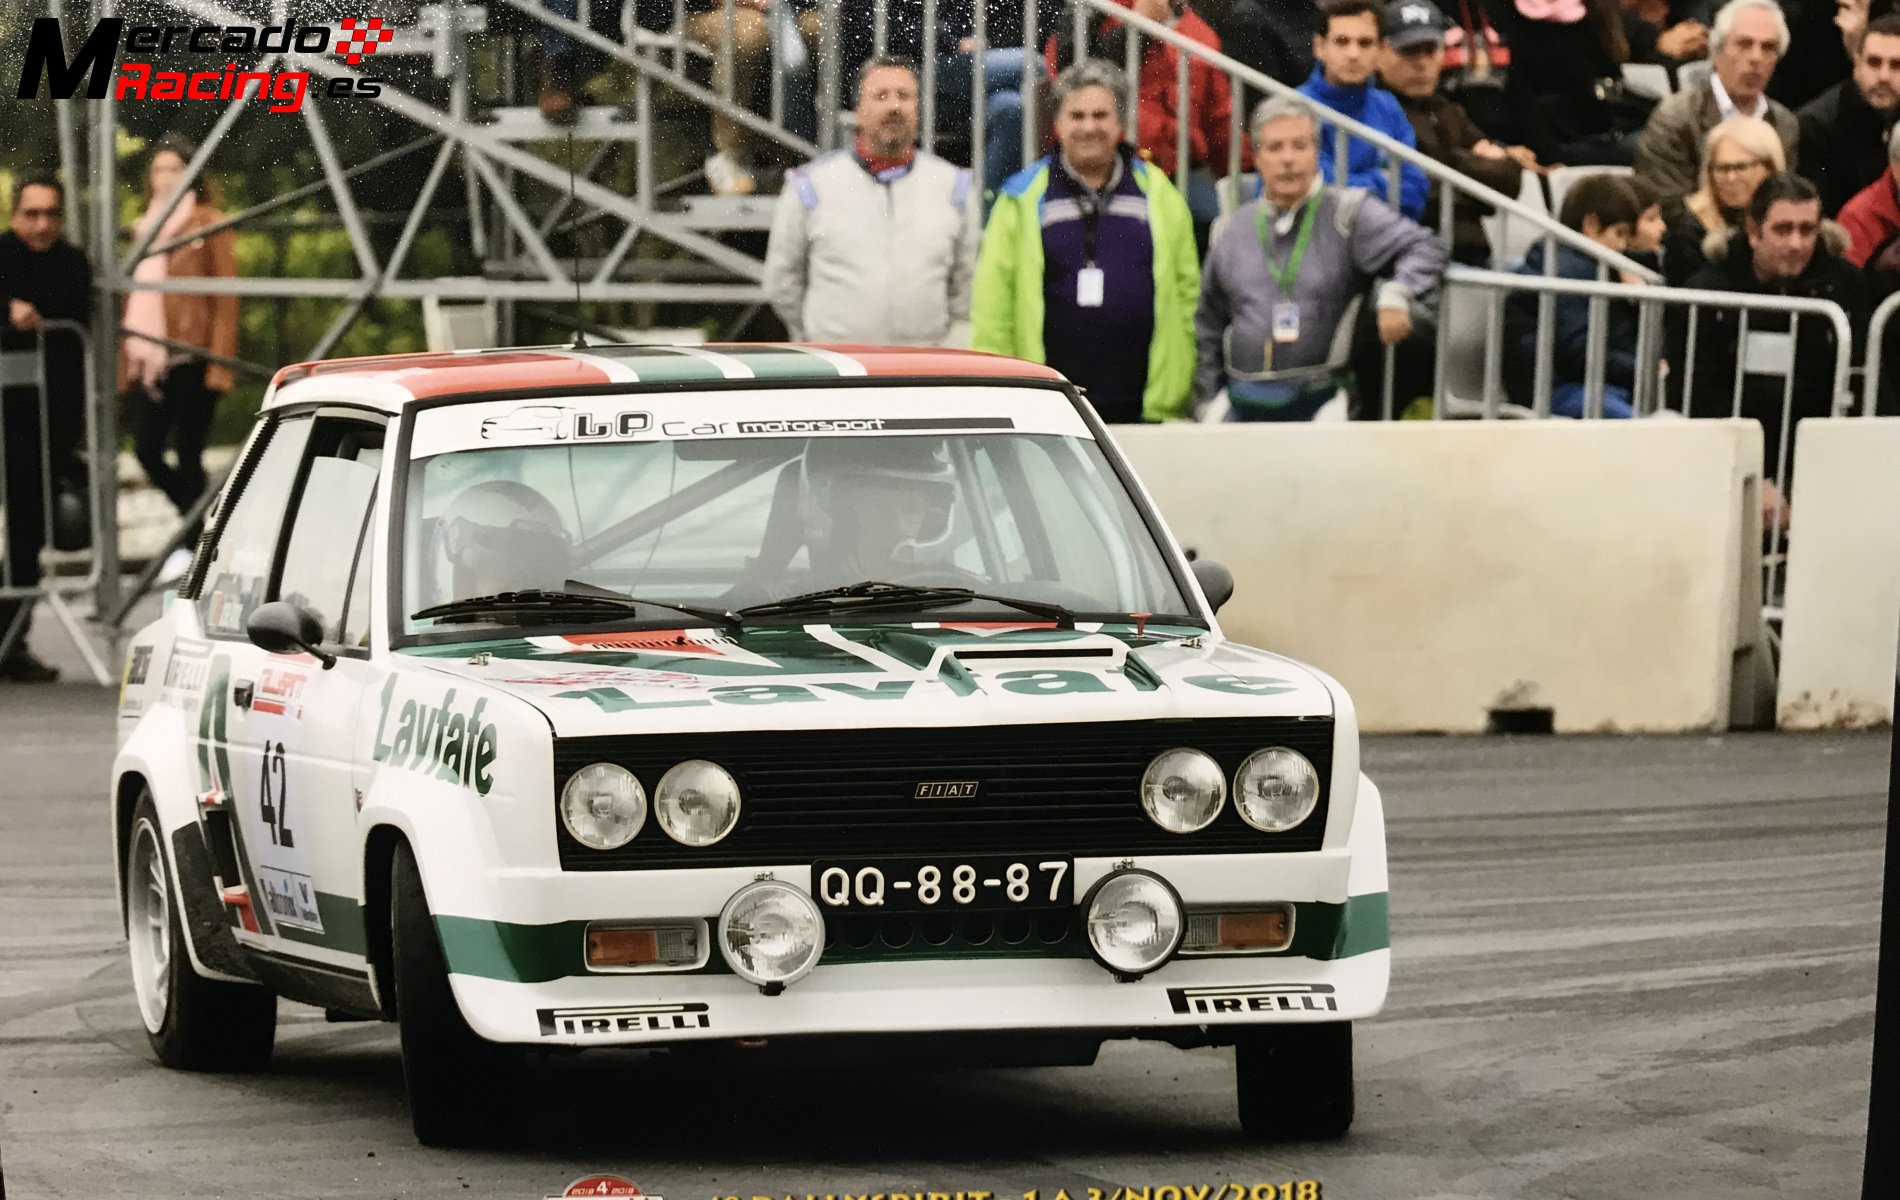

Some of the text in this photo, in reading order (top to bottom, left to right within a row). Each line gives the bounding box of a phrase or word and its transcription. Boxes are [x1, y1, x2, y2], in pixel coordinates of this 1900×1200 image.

[742, 418, 886, 433] motorsport
[261, 739, 294, 848] 42
[916, 783, 977, 798] FIAT
[819, 861, 1068, 907] QQ-88-87
[1166, 983, 1337, 1014] PIRELLI
[536, 1002, 710, 1036] PIRELLI
